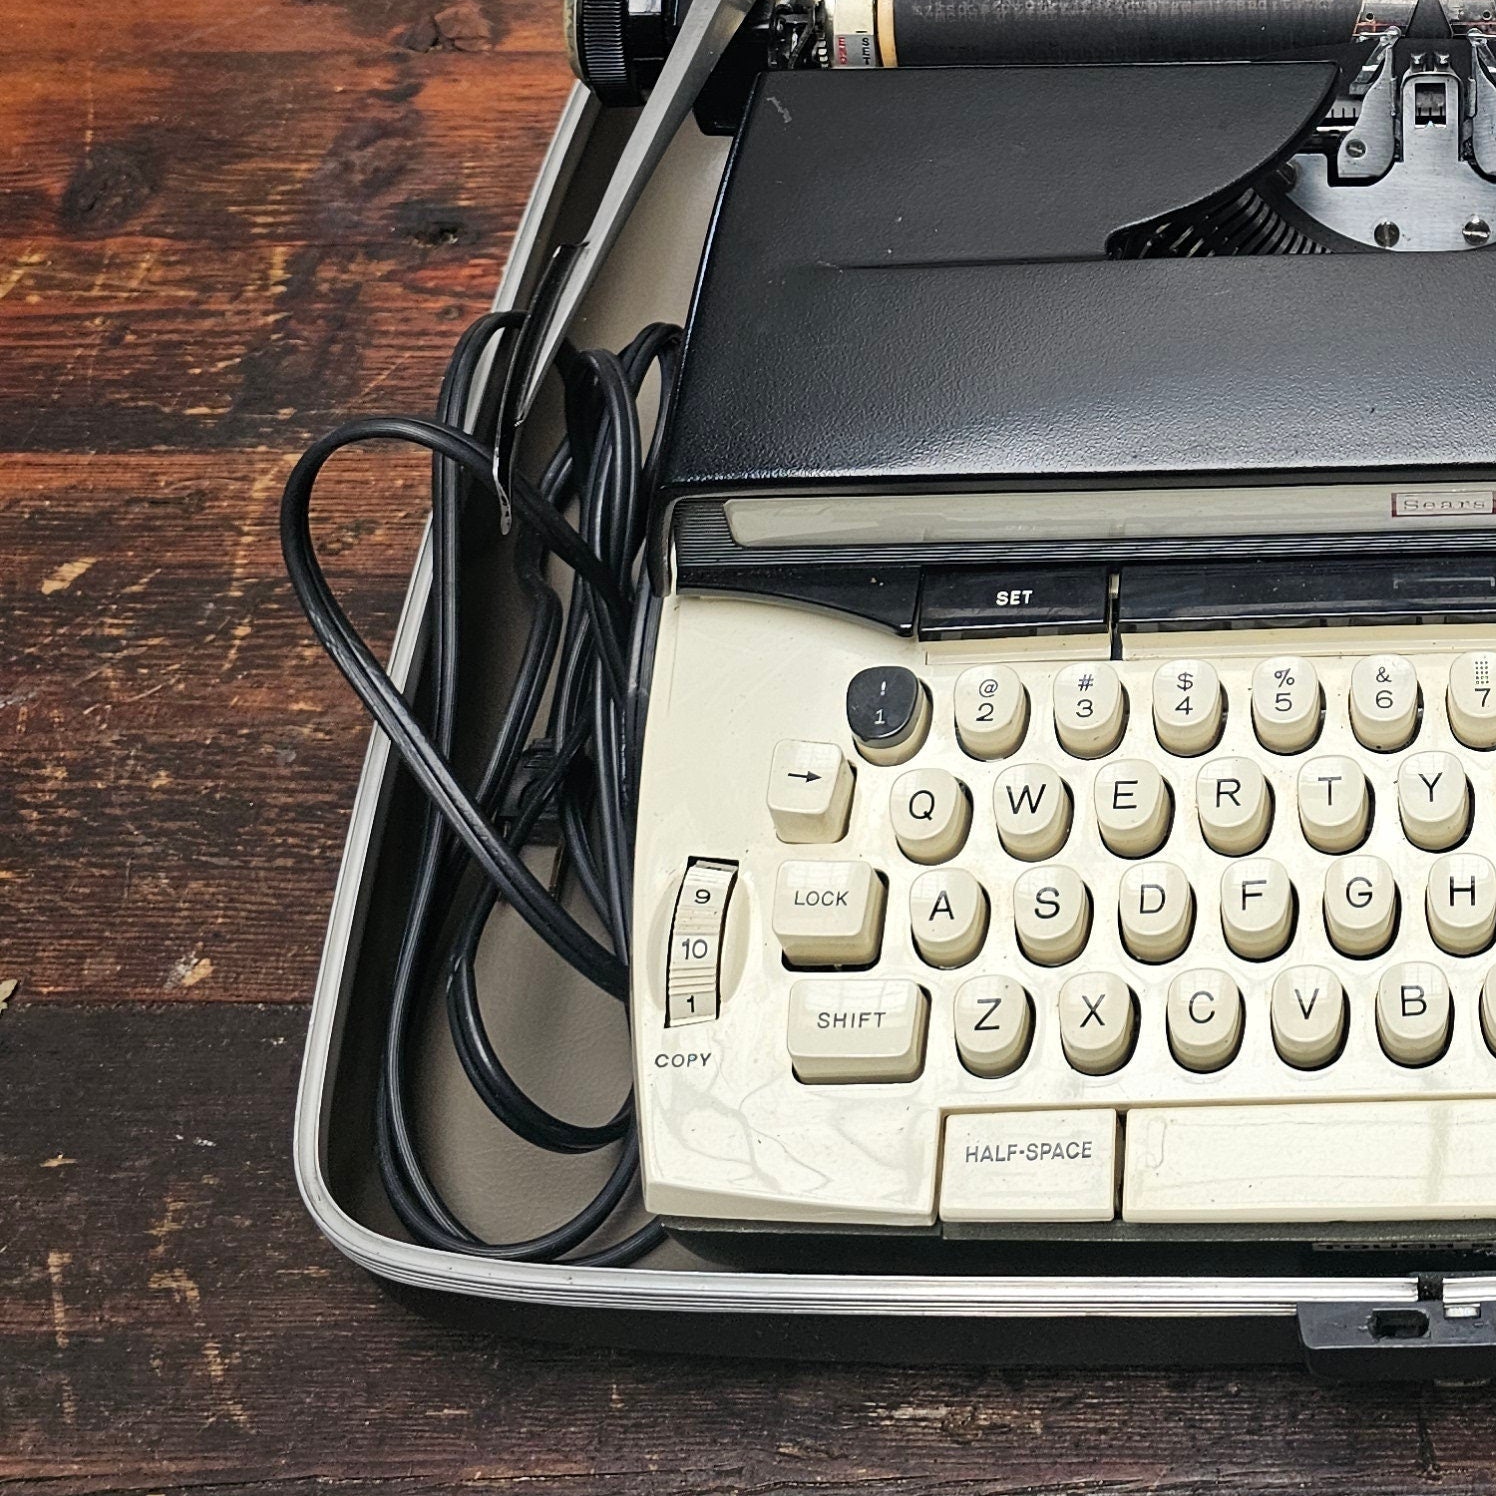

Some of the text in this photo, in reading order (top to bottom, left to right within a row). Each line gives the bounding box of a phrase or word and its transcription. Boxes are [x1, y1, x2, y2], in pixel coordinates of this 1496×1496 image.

[862, 38, 871, 65] SET
[1404, 495, 1484, 510] Sears
[996, 590, 1033, 606] SET
[976, 702, 994, 722] 2
[1075, 700, 1093, 717] 3
[1175, 697, 1194, 715] 4
[1275, 693, 1292, 711] 5
[1375, 690, 1393, 709] 6
[1475, 689, 1491, 708] 7
[874, 709, 886, 725] 1
[1006, 783, 1046, 815] W
[1112, 780, 1138, 809] E
[1215, 778, 1241, 807] R
[1318, 776, 1342, 806] T
[1418, 772, 1443, 802] Y
[908, 789, 936, 821] Q
[694, 889, 711, 904] 9
[794, 891, 849, 907] LOCK
[1035, 888, 1060, 919] S
[1139, 884, 1165, 914] D
[1241, 880, 1267, 910] F
[1346, 877, 1373, 908] G
[1448, 876, 1476, 907] H
[929, 891, 954, 921] A
[681, 939, 708, 959] 10
[686, 996, 695, 1012] 1
[1080, 995, 1105, 1027] X
[1188, 991, 1215, 1024] C
[1294, 988, 1319, 1019] V
[1401, 985, 1427, 1016] B
[817, 1012, 886, 1029] SHIFT
[974, 999, 1001, 1031] Z
[655, 1052, 712, 1068] COPY
[965, 1141, 1093, 1163] HALF-SPACE
